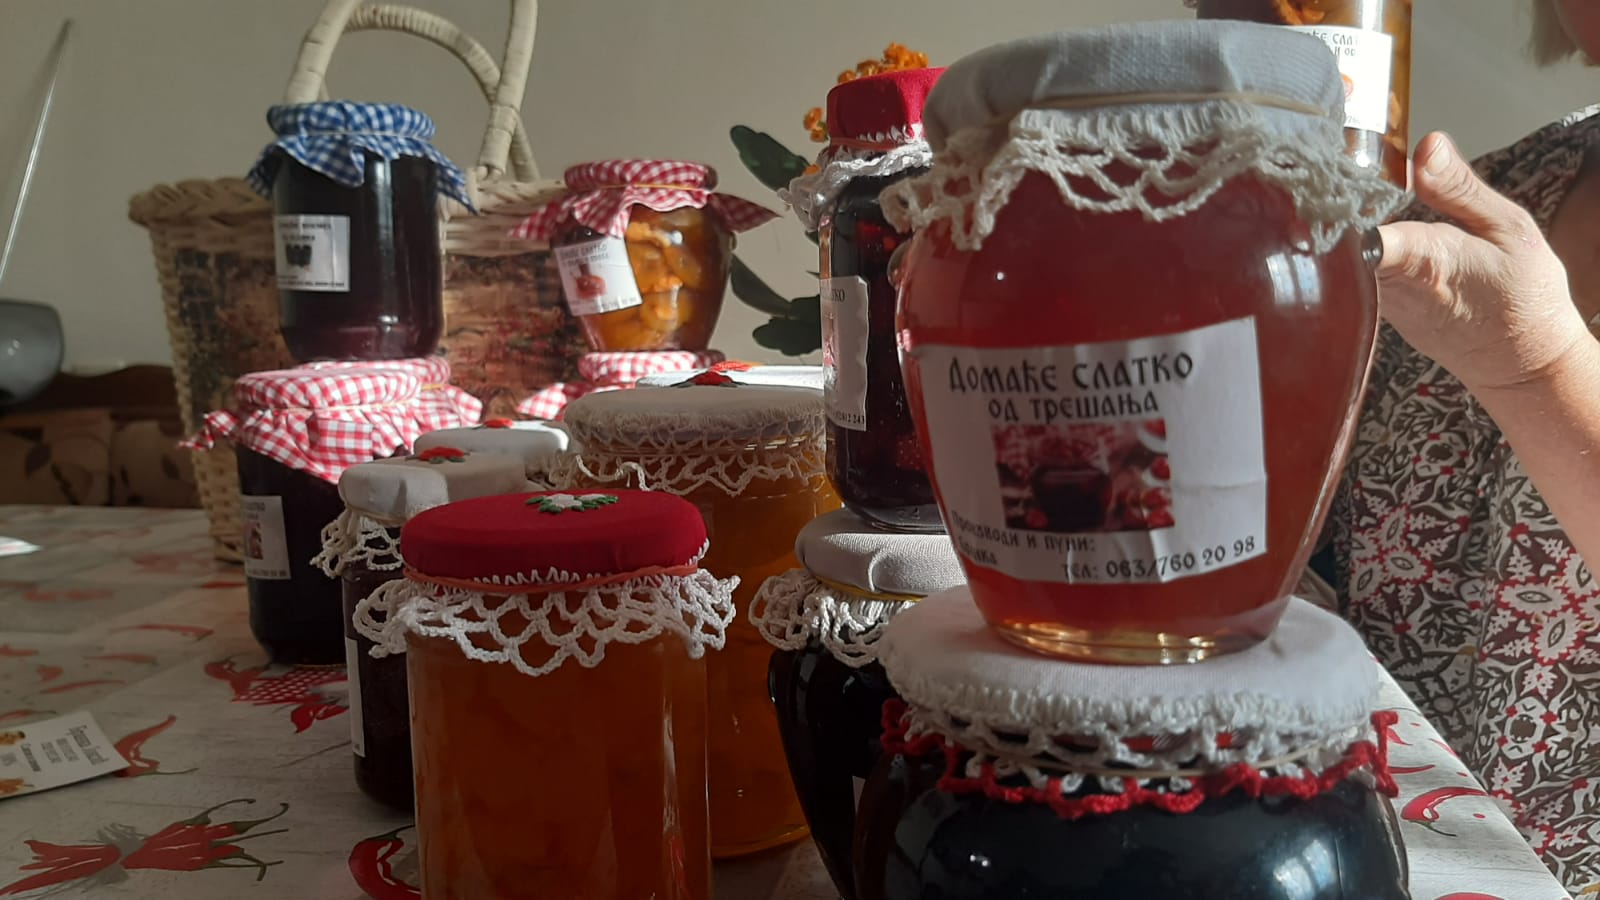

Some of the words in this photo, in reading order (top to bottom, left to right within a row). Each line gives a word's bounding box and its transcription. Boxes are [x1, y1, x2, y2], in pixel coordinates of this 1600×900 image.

[1105, 552, 1196, 578] 063/760
[1202, 547, 1226, 566] 20
[1233, 535, 1256, 557] 98
